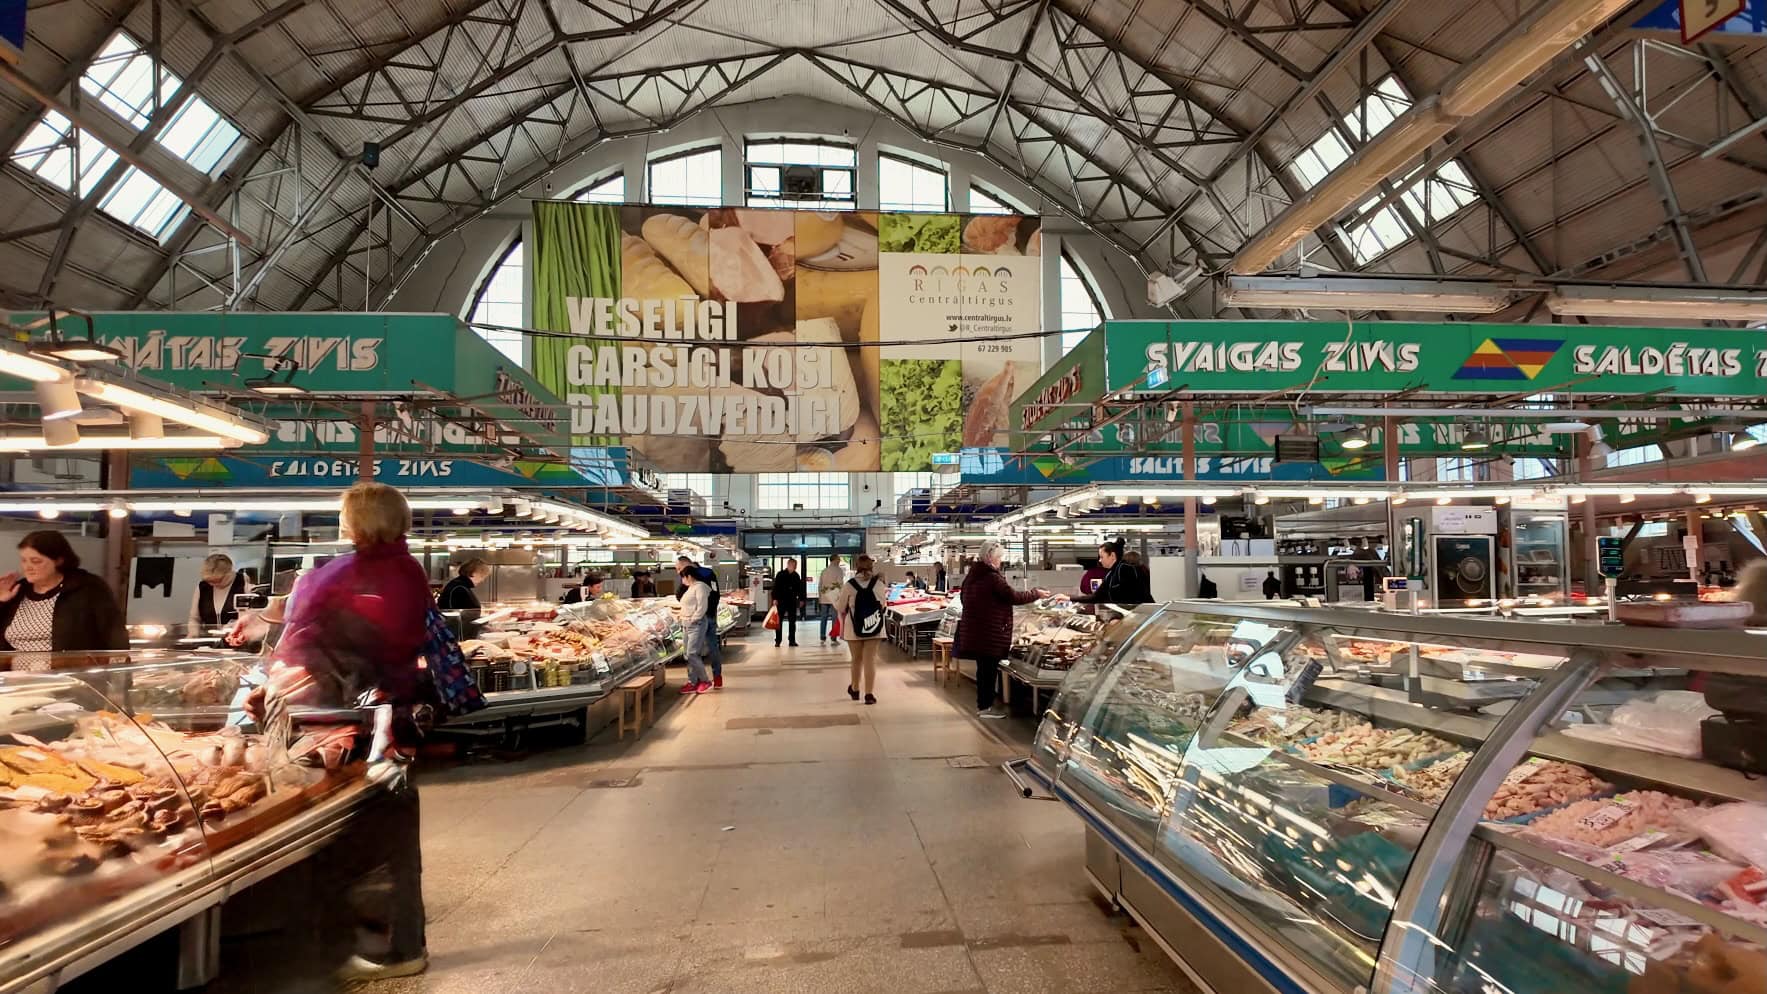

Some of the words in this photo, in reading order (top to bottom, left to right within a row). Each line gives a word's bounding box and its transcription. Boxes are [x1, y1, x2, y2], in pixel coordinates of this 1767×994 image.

[566, 295, 738, 341] VESELĪGI
[262, 335, 384, 374] ZIVIS
[1143, 340, 1304, 373] SVAIGAS
[1573, 342, 1743, 378] SALDĒTAS
[567, 390, 841, 436] DAUDZVEIDĪGI
[863, 609, 882, 630] NIKE
